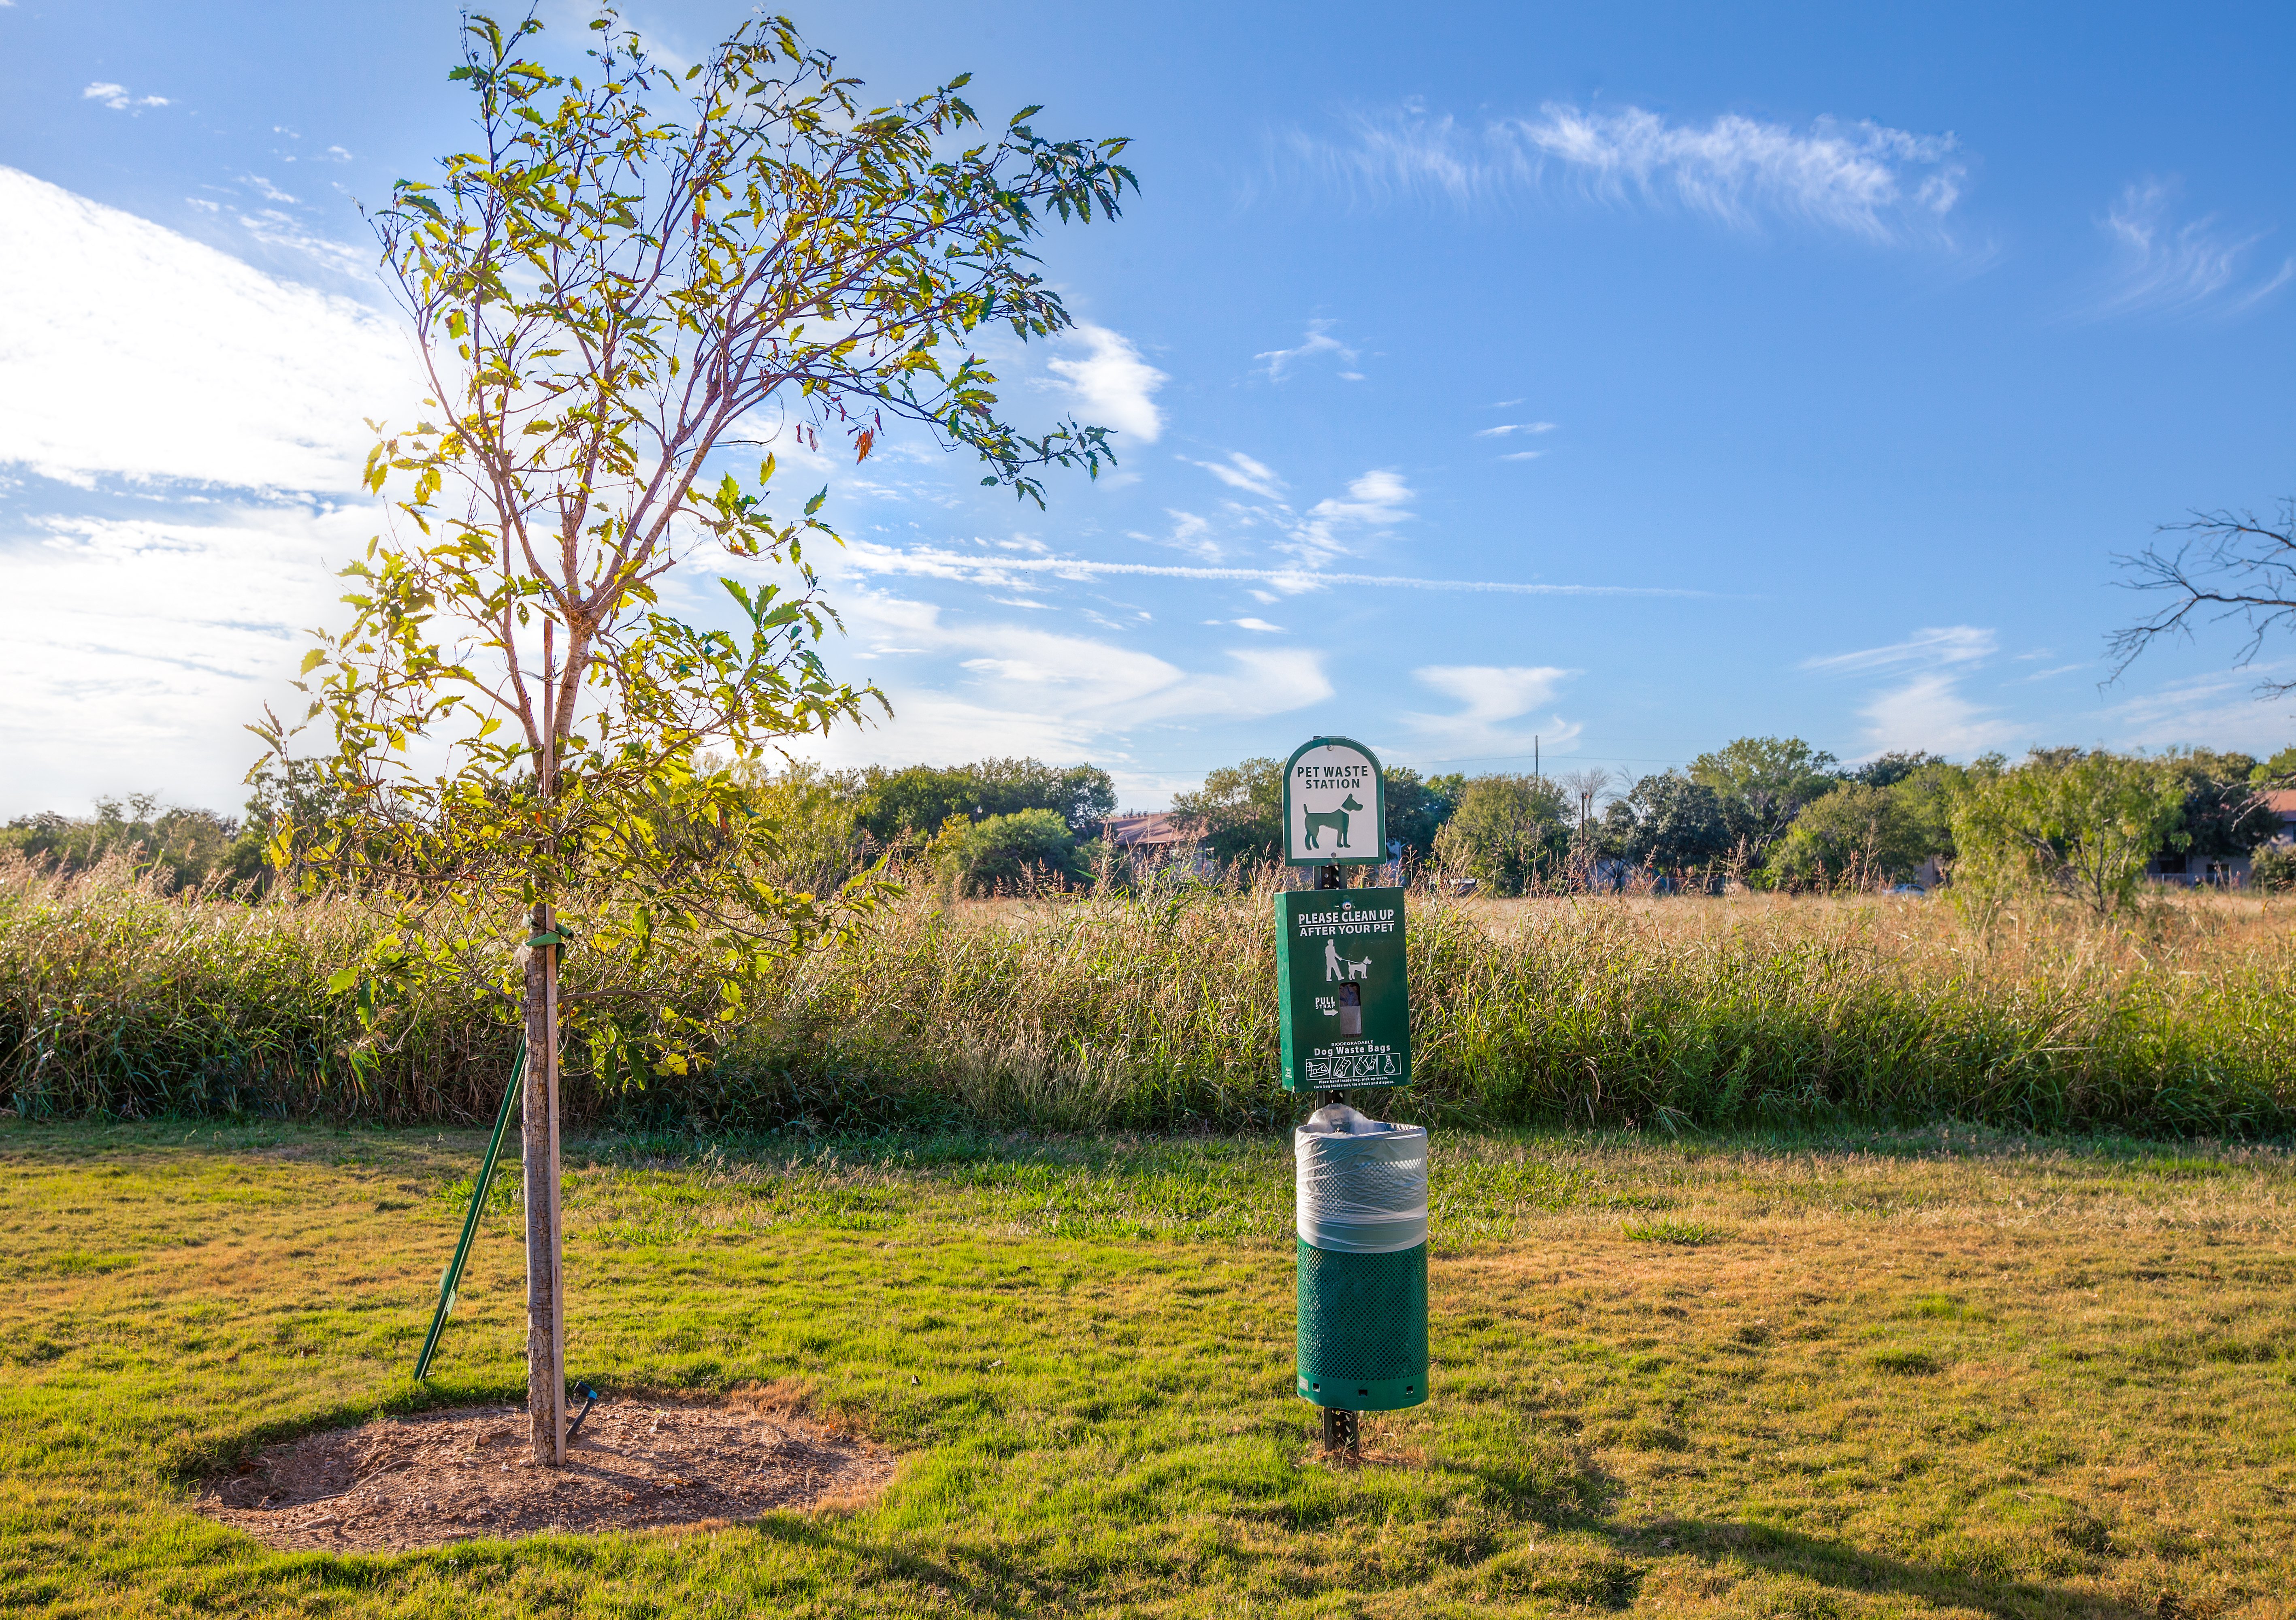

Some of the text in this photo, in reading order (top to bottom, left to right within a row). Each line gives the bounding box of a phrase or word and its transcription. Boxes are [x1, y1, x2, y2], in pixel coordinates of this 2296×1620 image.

[1297, 766, 1368, 777] PET WASTE
[1306, 779, 1360, 789] STATION
[1299, 909, 1394, 924] PLEASE CLEAN UP
[1300, 923, 1394, 936] AFTER YOUR PET
[1315, 996, 1335, 1005] PULL
[1314, 1044, 1391, 1056] Dog Waste Bags
